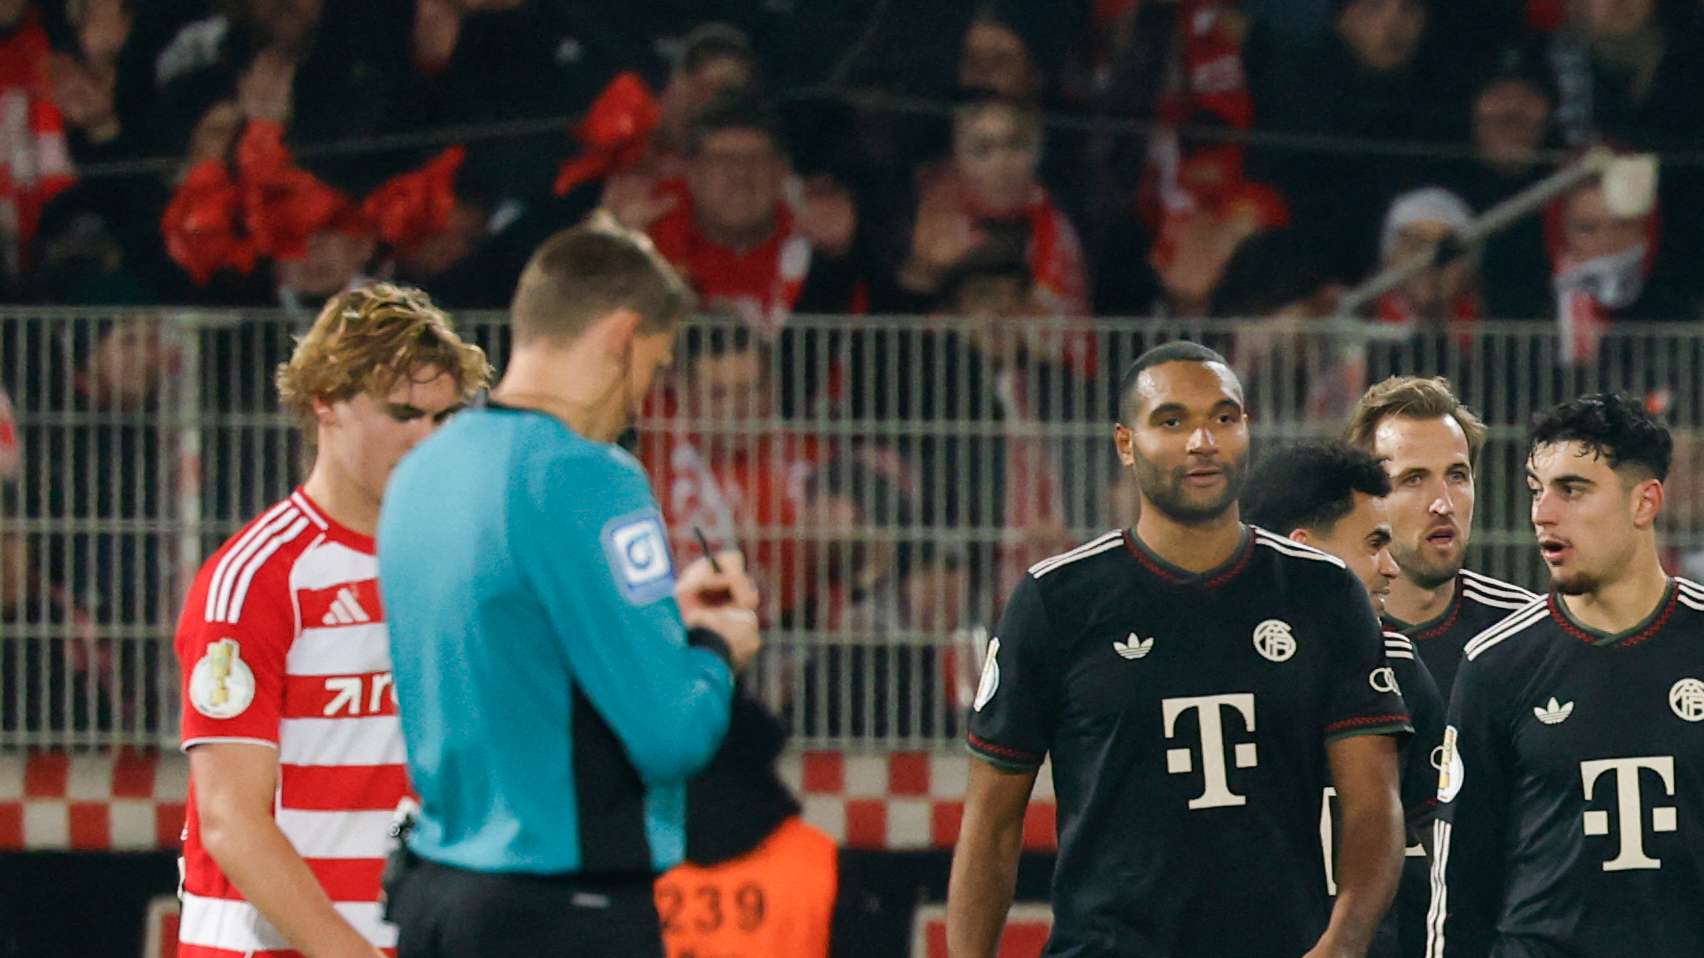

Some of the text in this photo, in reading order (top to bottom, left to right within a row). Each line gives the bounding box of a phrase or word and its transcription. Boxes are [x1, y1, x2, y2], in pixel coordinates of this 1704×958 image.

[1162, 693, 1258, 810] T
[1580, 756, 1677, 871] T
[655, 880, 766, 933] 239
